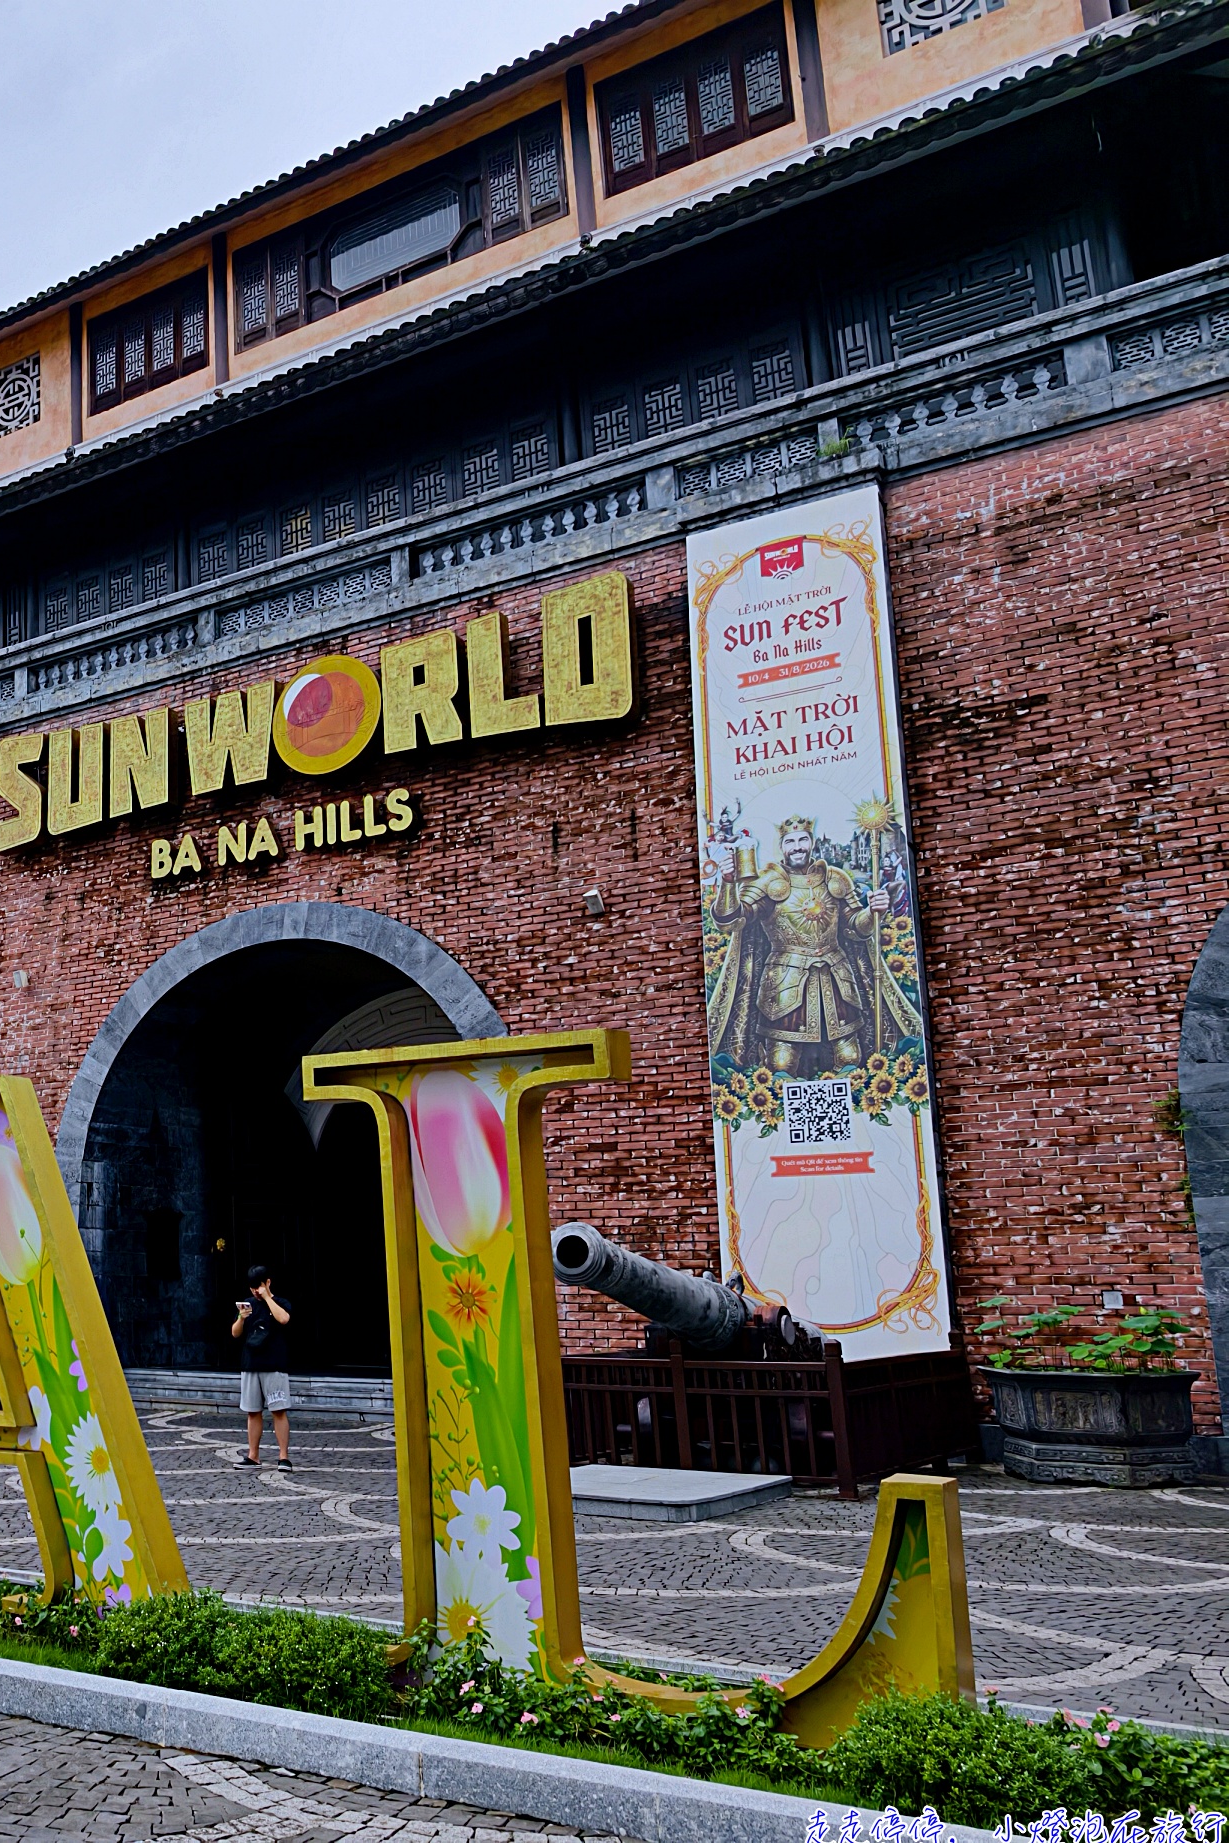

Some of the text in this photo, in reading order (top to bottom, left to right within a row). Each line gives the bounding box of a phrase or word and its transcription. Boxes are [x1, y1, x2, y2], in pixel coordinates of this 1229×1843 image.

[738, 586, 832, 616] LỄ HỘI MẶT TRỜI
[753, 637, 823, 664] Ba Na Hills
[184, 571, 636, 796] WORLD
[747, 659, 830, 684] 10/4 31/8/2026
[726, 693, 860, 739] MẶT TRỜI
[734, 723, 854, 765] KHAI HỘI
[734, 751, 857, 781] LỄ HỘI LỚN NHẤT NĂM
[150, 787, 414, 880] BA NA HILLS
